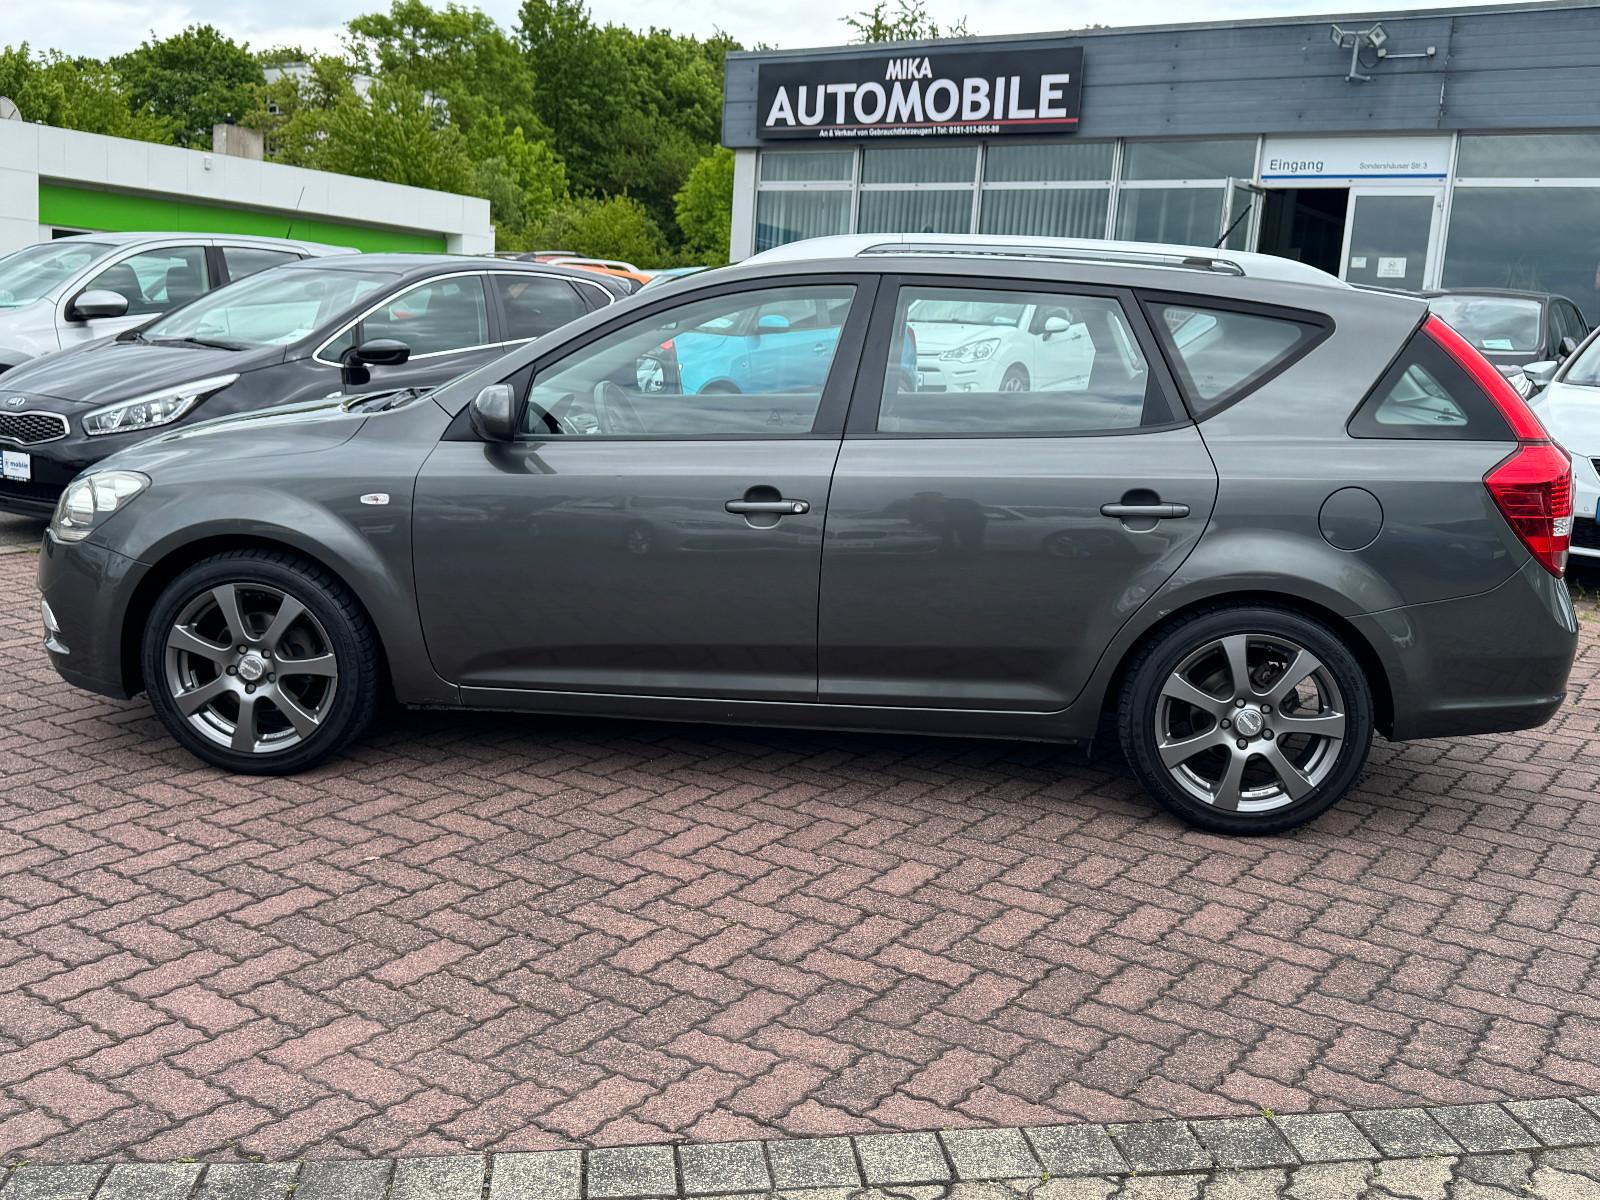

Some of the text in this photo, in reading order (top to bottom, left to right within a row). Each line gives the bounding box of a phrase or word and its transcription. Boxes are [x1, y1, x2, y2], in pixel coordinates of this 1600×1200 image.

[885, 57, 933, 81] MIKA
[765, 73, 1070, 127] AUTOMOBILE
[819, 129, 828, 137] An
[834, 129, 857, 137] Verkauf
[869, 127, 932, 137] Gebrauchtfahrzeugen
[1269, 158, 1324, 173] Eingang
